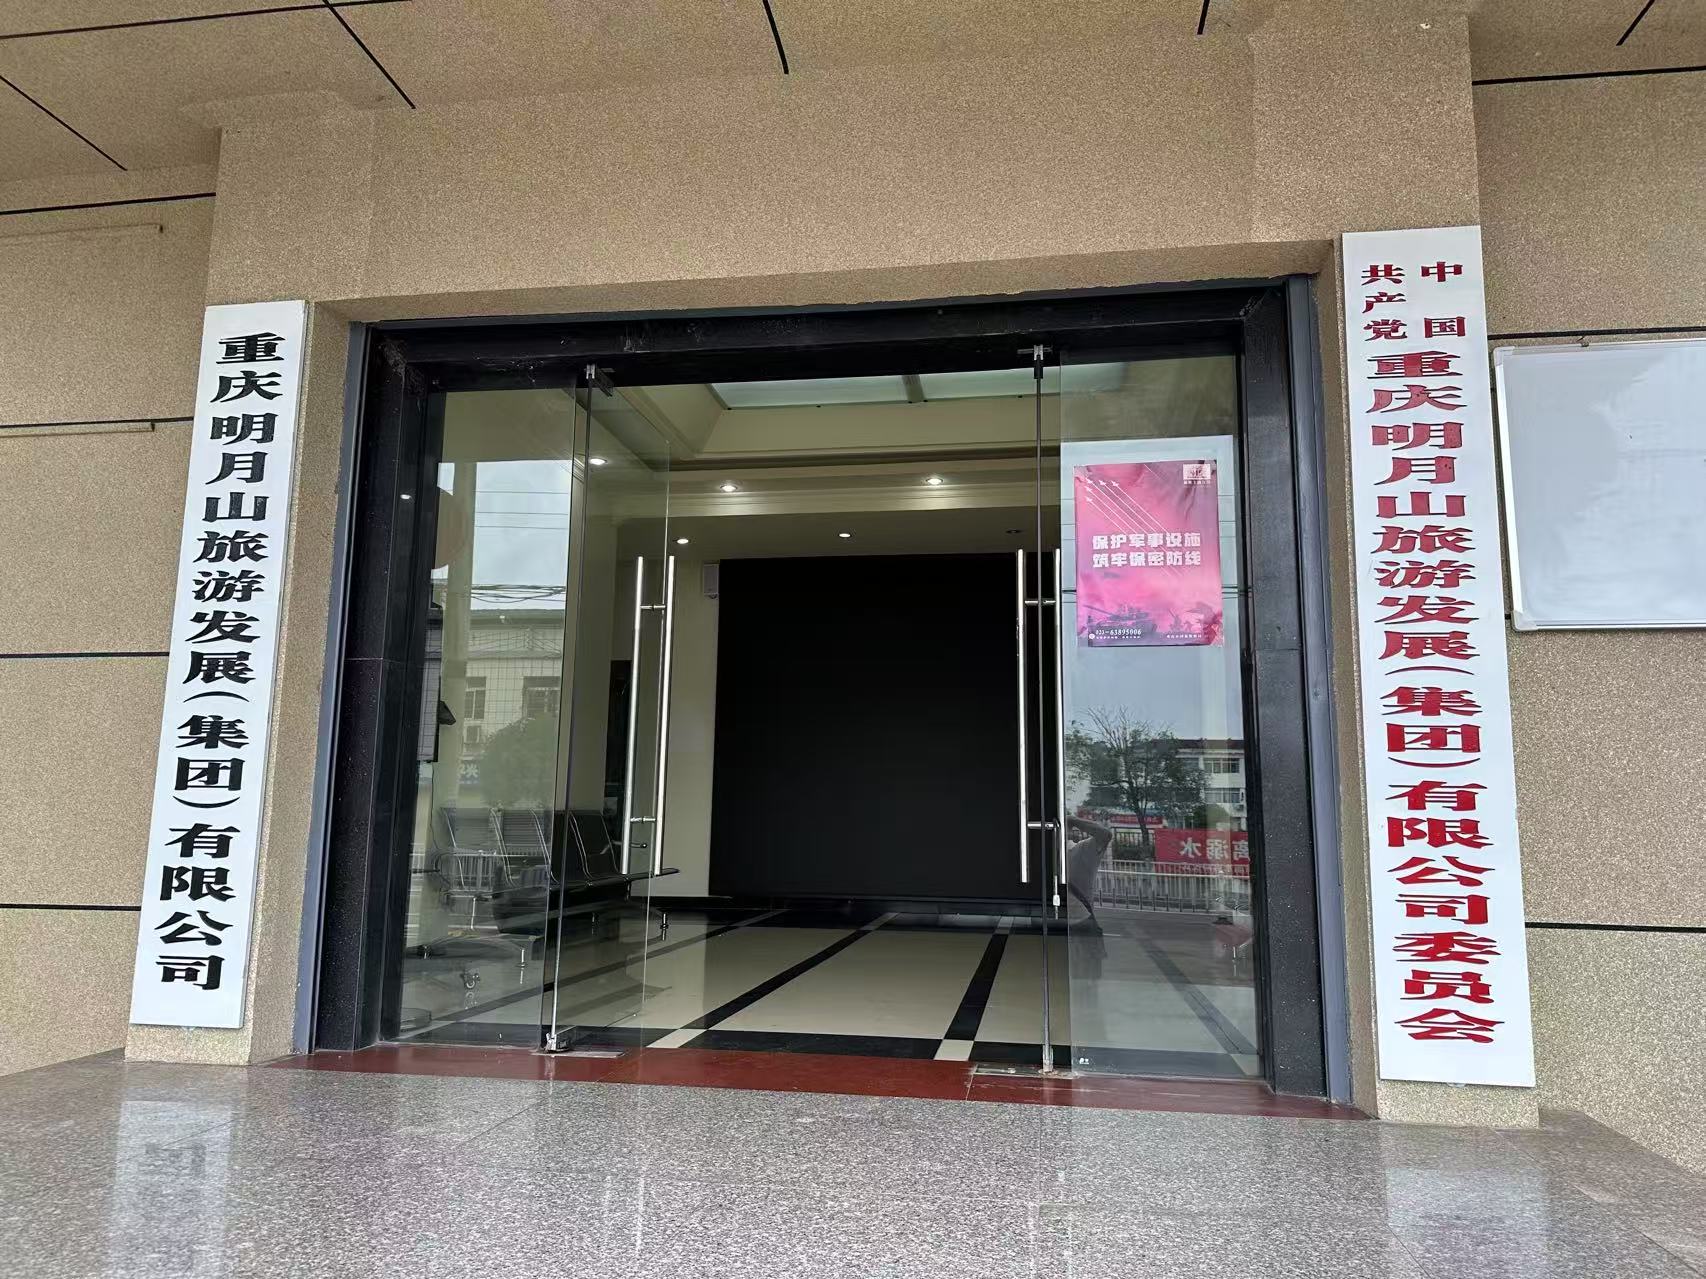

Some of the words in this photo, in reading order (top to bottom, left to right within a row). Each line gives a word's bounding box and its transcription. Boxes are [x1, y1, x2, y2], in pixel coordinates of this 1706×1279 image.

[1361, 263, 1408, 340] 共产党
[1421, 261, 1466, 338] 中国
[1092, 532, 1201, 550] 保护军事设施
[1092, 551, 1201, 568] 筑牢保密防线
[153, 333, 285, 992] 重庆明月山旅游发展（集团）有限公司
[1365, 350, 1505, 1044] 重庆明月山旅游发展（集团）有限公司委员会
